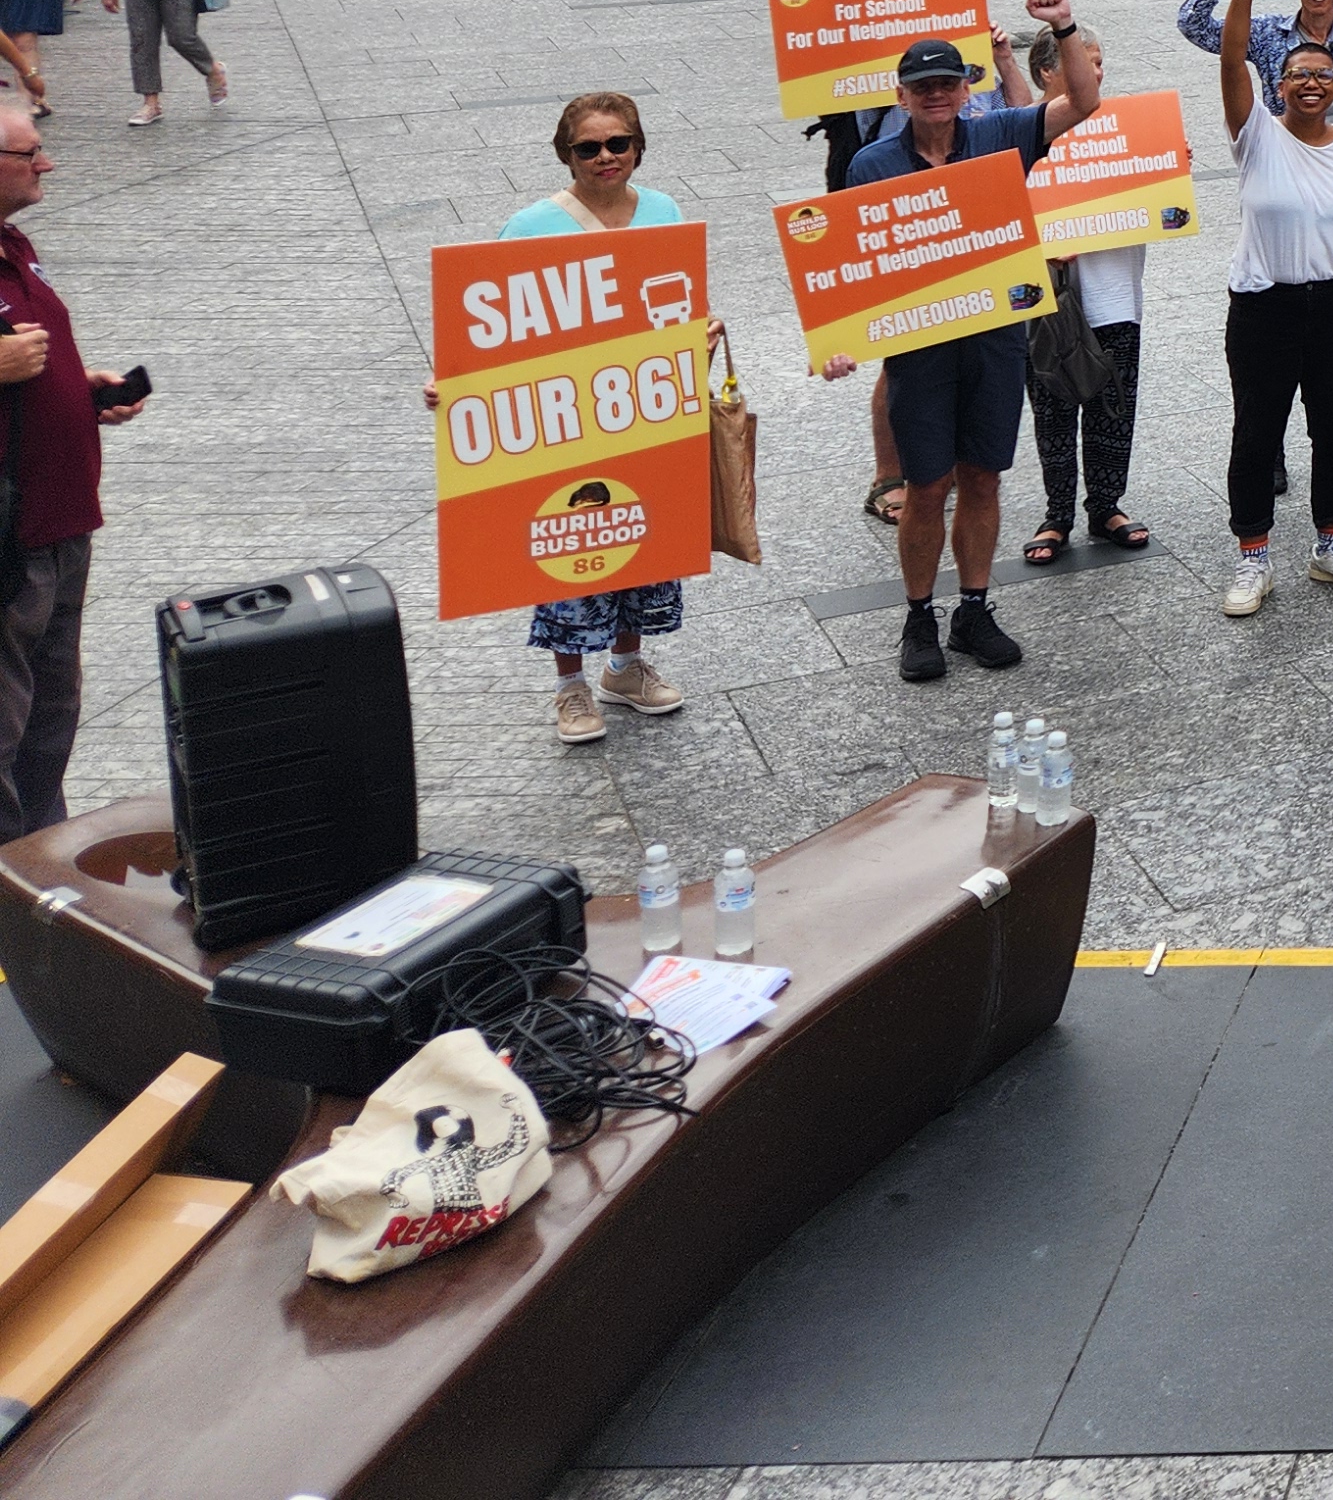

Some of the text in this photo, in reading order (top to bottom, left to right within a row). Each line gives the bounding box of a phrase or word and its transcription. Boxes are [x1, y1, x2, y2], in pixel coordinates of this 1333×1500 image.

[786, 9, 976, 50] For Our Neighbourhood!
[835, 3, 861, 21] For
[1054, 150, 1178, 185] Neighbourhood!
[1068, 134, 1129, 161] School!
[858, 186, 949, 226] For Work!
[1039, 205, 1151, 245] #SAVEOUR86
[857, 209, 963, 253] For School!
[805, 212, 1024, 293] For Our Neighbourhood!
[463, 254, 624, 349] SAVE
[867, 288, 996, 342] #SAVEOUR86
[449, 350, 700, 464] OUR 86!
[530, 505, 646, 538] KURILPA
[530, 523, 647, 557] BUS LOOP
[573, 555, 606, 575] 86
